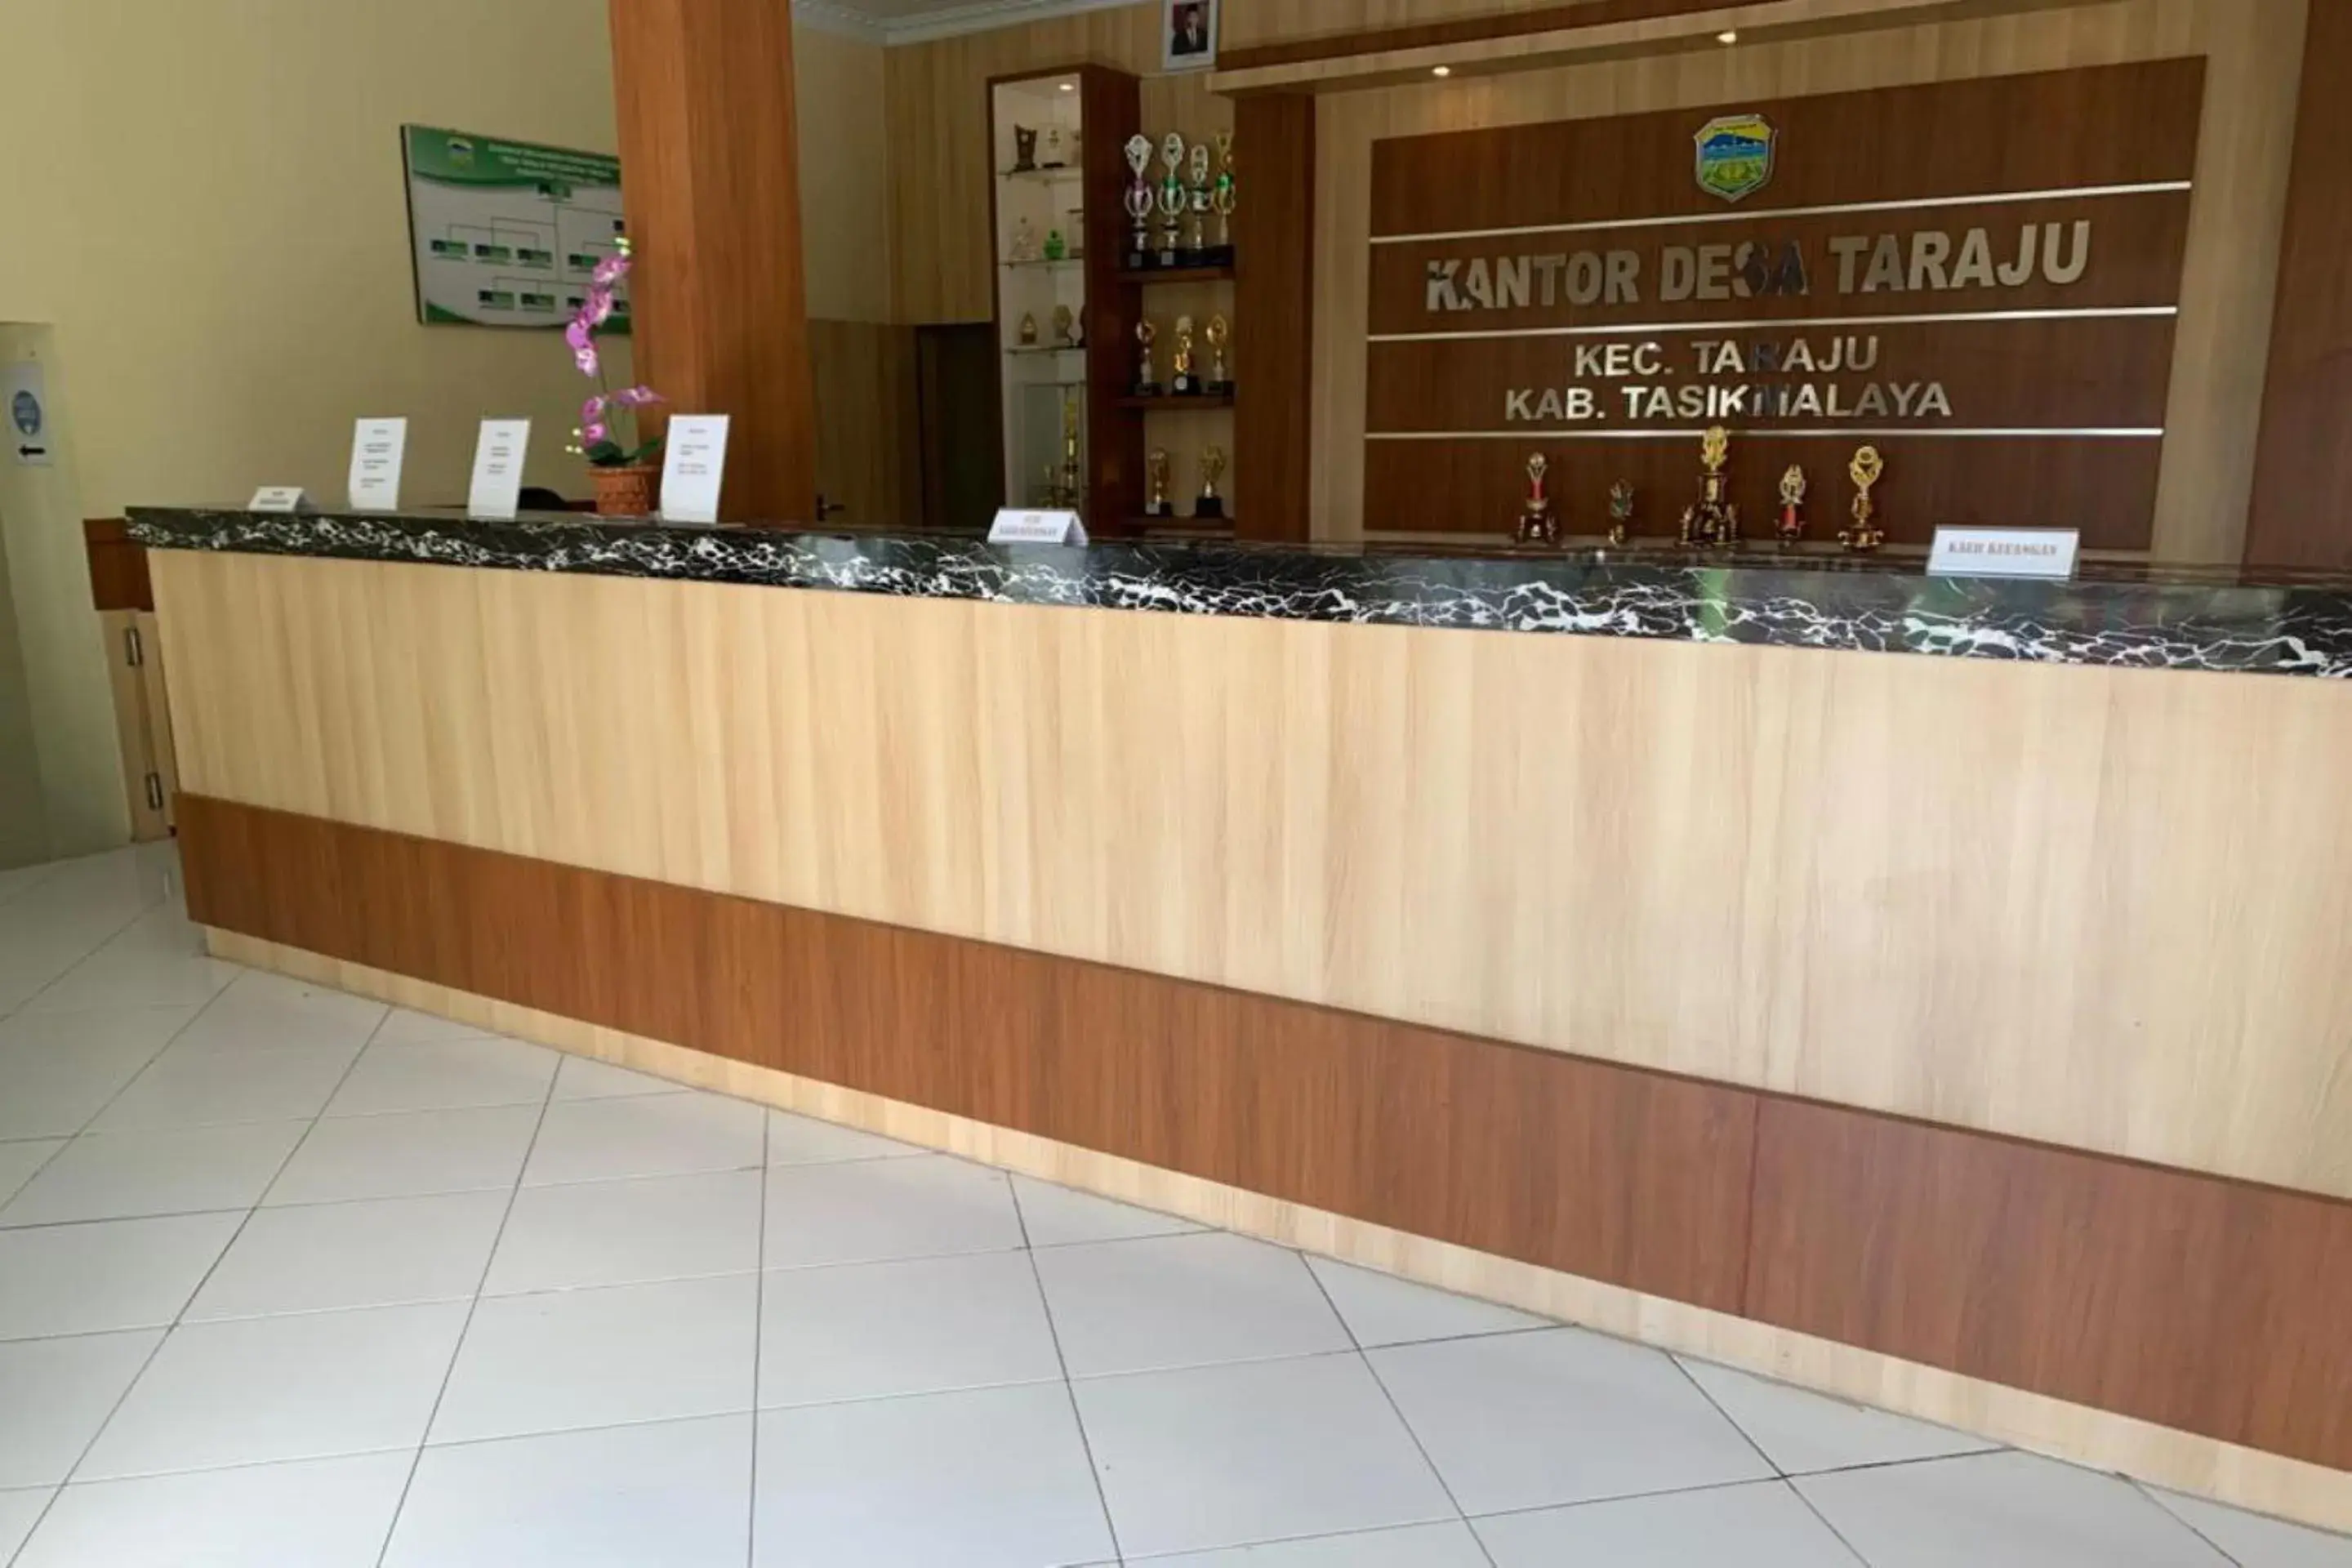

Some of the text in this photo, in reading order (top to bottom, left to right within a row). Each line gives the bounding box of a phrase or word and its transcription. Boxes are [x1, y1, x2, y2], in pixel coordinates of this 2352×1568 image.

[1426, 220, 2091, 312] KANTOR DESA TARAJU
[1575, 336, 1878, 377] KEC. TARAJU
[1505, 381, 1953, 421] KAB. TASIKMALAYA
